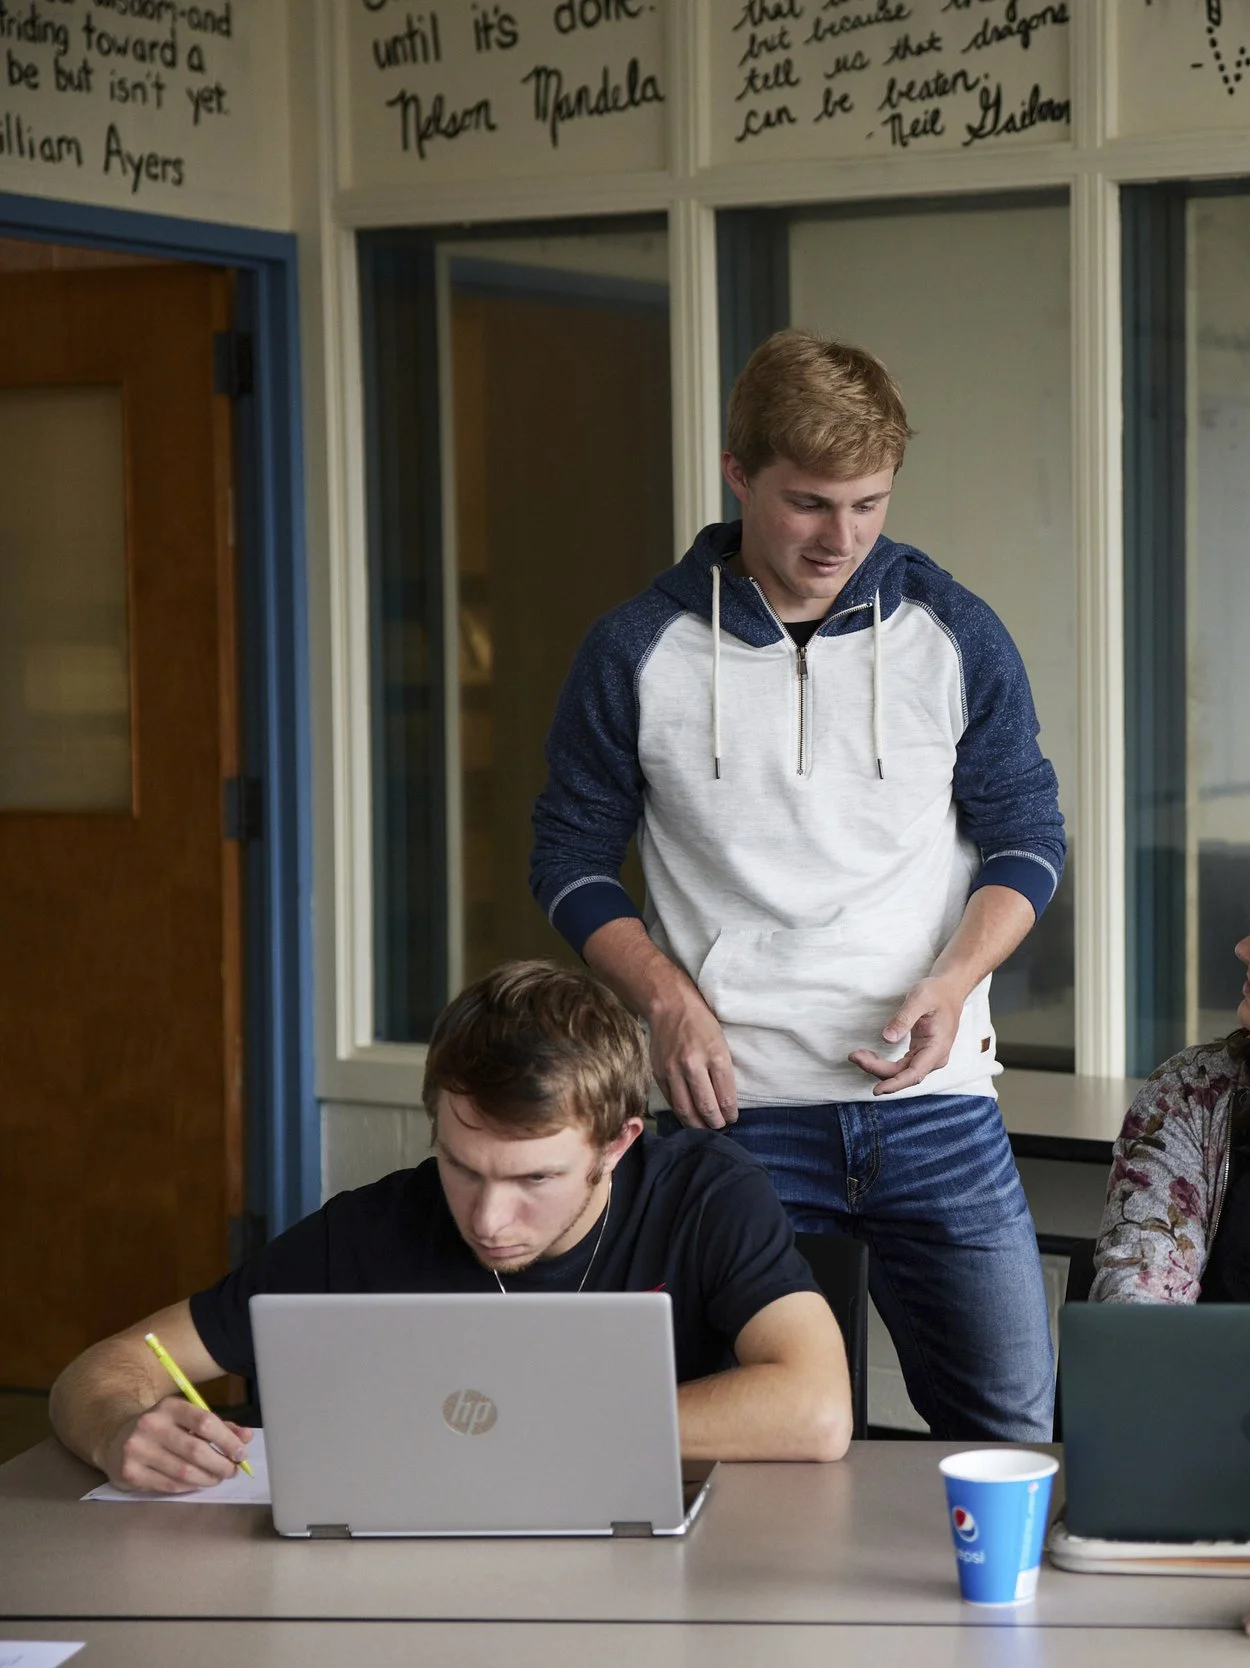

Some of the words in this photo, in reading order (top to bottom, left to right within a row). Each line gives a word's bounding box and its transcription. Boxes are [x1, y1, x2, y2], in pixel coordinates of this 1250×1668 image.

[82, 12, 177, 69] toward
[187, 44, 206, 74] a
[373, 11, 441, 69] until
[472, 3, 519, 53] it's
[735, 59, 801, 101] tell
[823, 54, 871, 79] us
[882, 31, 943, 66] that
[961, 2, 1070, 51] dragons
[738, 26, 792, 68] but
[803, 2, 912, 44] because
[7, 48, 39, 90] be
[54, 54, 94, 93] but
[109, 68, 165, 110] isn't
[186, 82, 229, 126] yet.
[386, 89, 496, 160] Nelson
[521, 57, 666, 148] Mandela
[735, 104, 796, 142] can
[813, 88, 854, 123] be
[877, 70, 990, 112] beaten.
[103, 121, 184, 194] Ayers
[450, 1390, 492, 1436] hp
